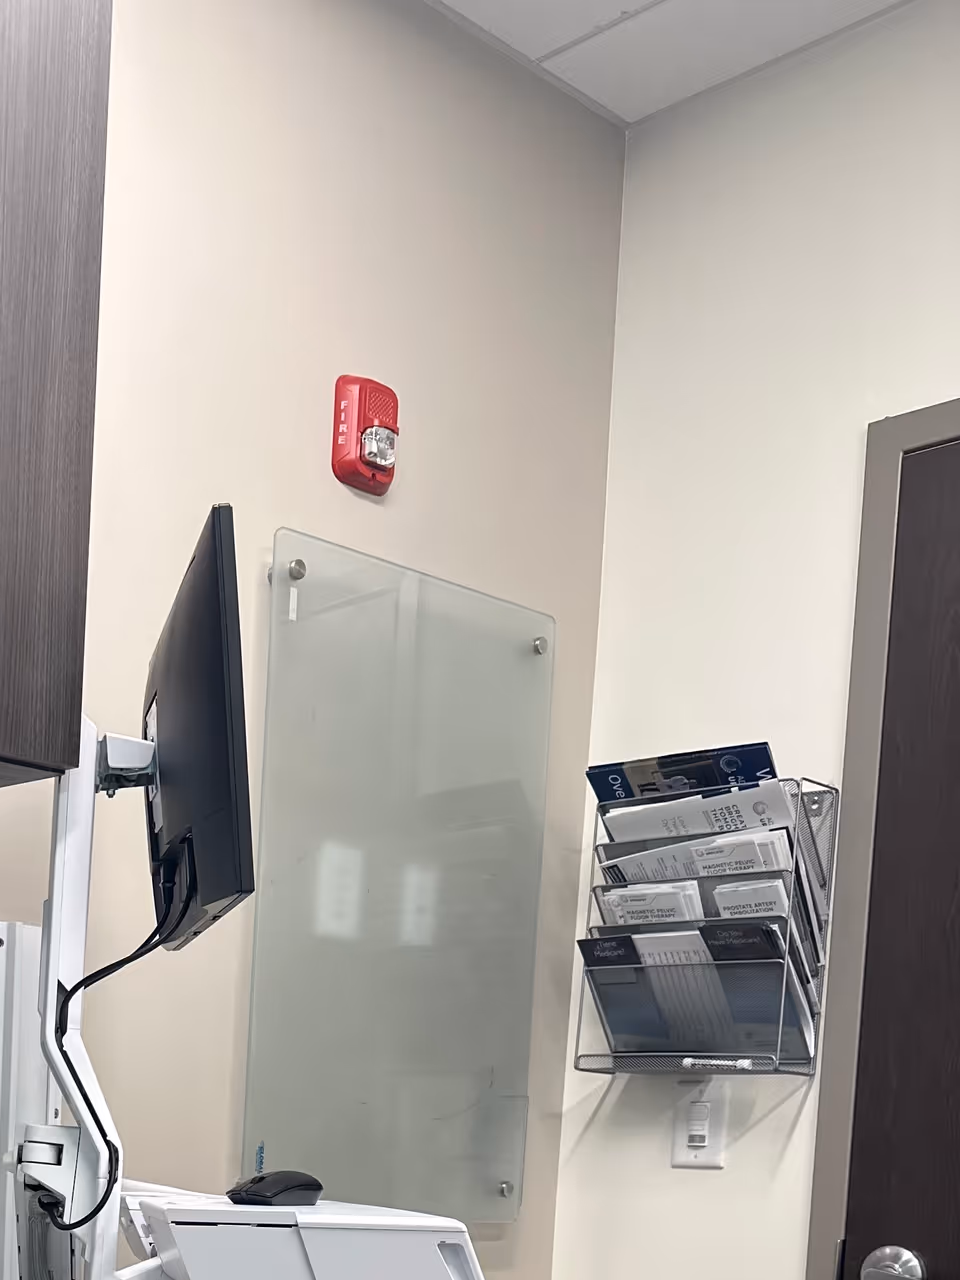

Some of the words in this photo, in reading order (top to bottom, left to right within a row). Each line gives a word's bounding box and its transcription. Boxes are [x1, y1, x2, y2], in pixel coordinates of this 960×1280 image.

[338, 401, 348, 444] FIRE
[703, 861, 734, 870] MAGNETIC
[730, 908, 774, 916] EMBOLIZATION
